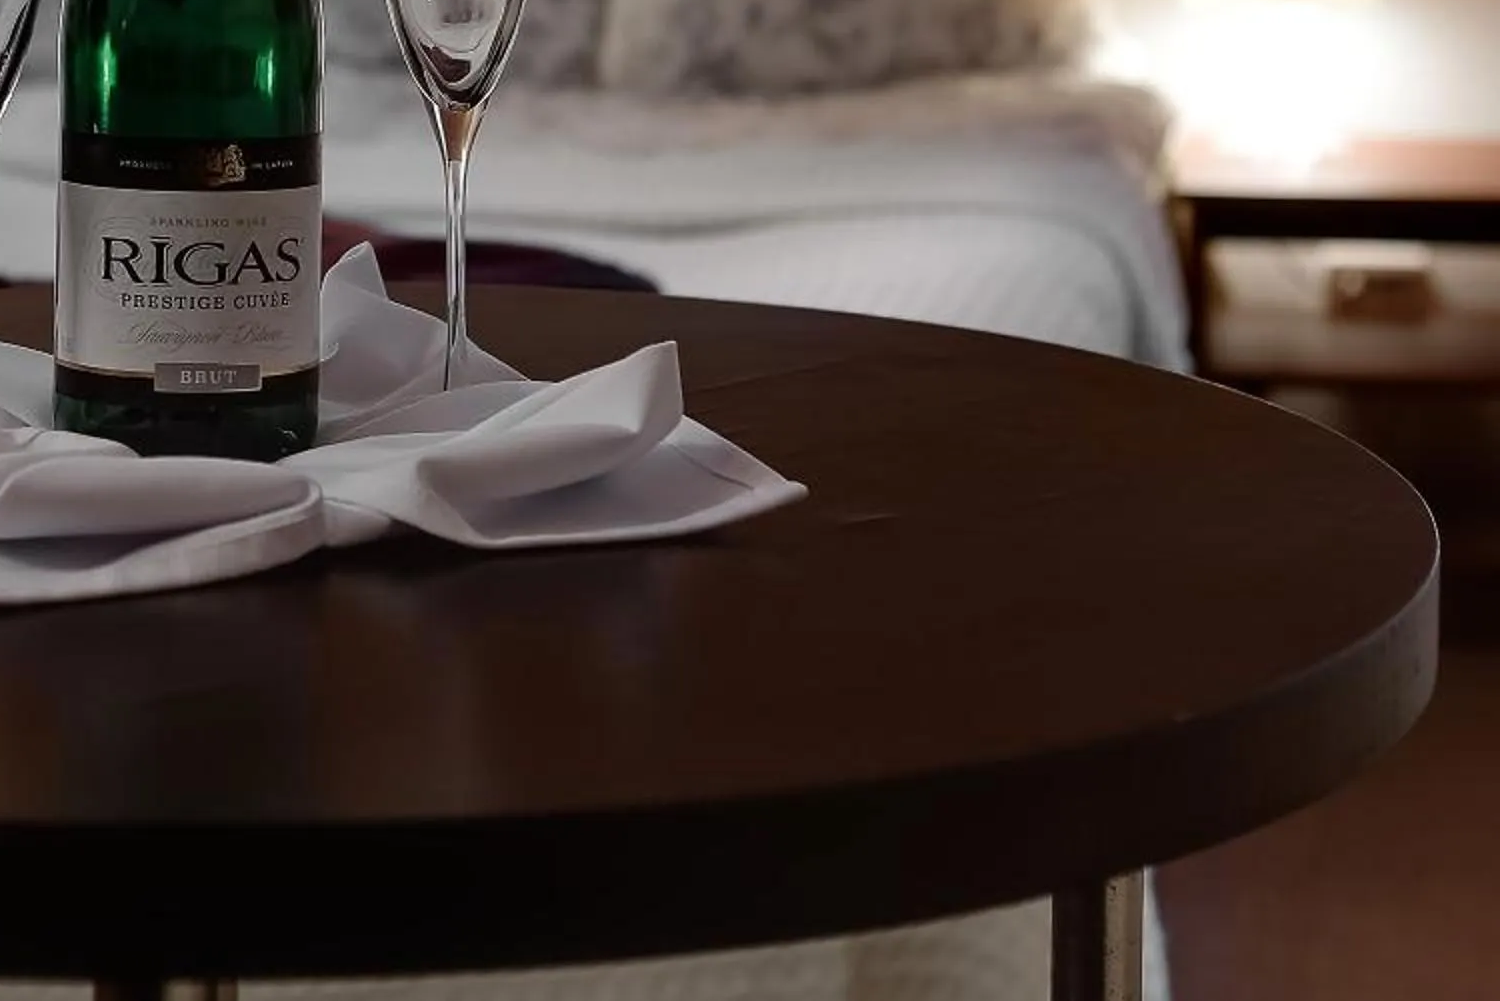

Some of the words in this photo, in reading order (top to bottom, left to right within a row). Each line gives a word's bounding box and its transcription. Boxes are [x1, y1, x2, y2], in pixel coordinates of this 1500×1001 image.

[101, 236, 301, 286] RĪGAS
[121, 293, 226, 310] PRESTIGE
[232, 291, 291, 310] CUVÉE
[180, 370, 238, 385] BRUT
